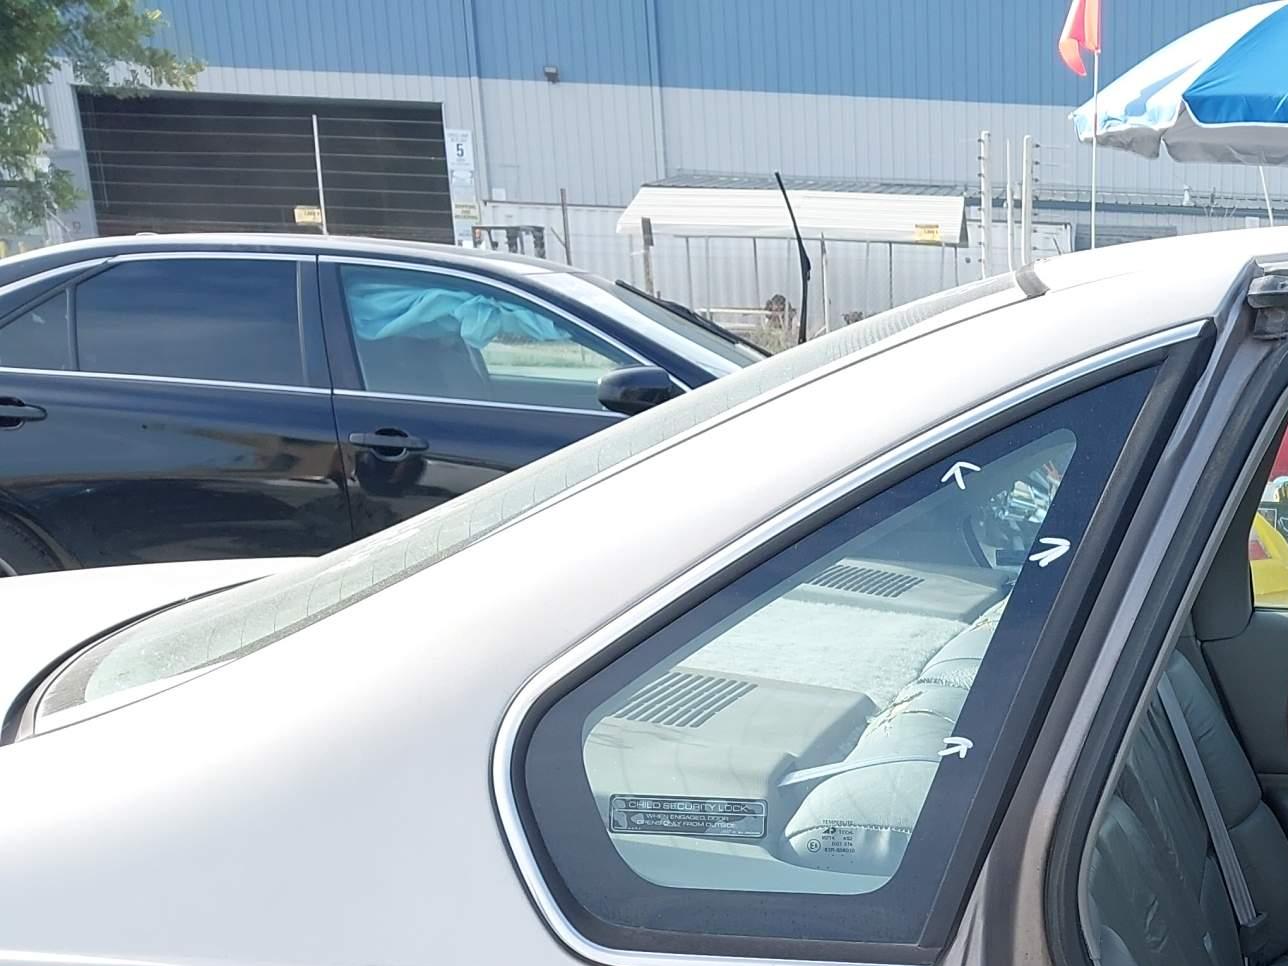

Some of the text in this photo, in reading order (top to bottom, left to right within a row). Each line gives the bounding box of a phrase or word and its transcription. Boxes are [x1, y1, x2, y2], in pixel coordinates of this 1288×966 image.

[456, 143, 465, 158] 5
[628, 800, 747, 812] CHILD SECURITY LOCK
